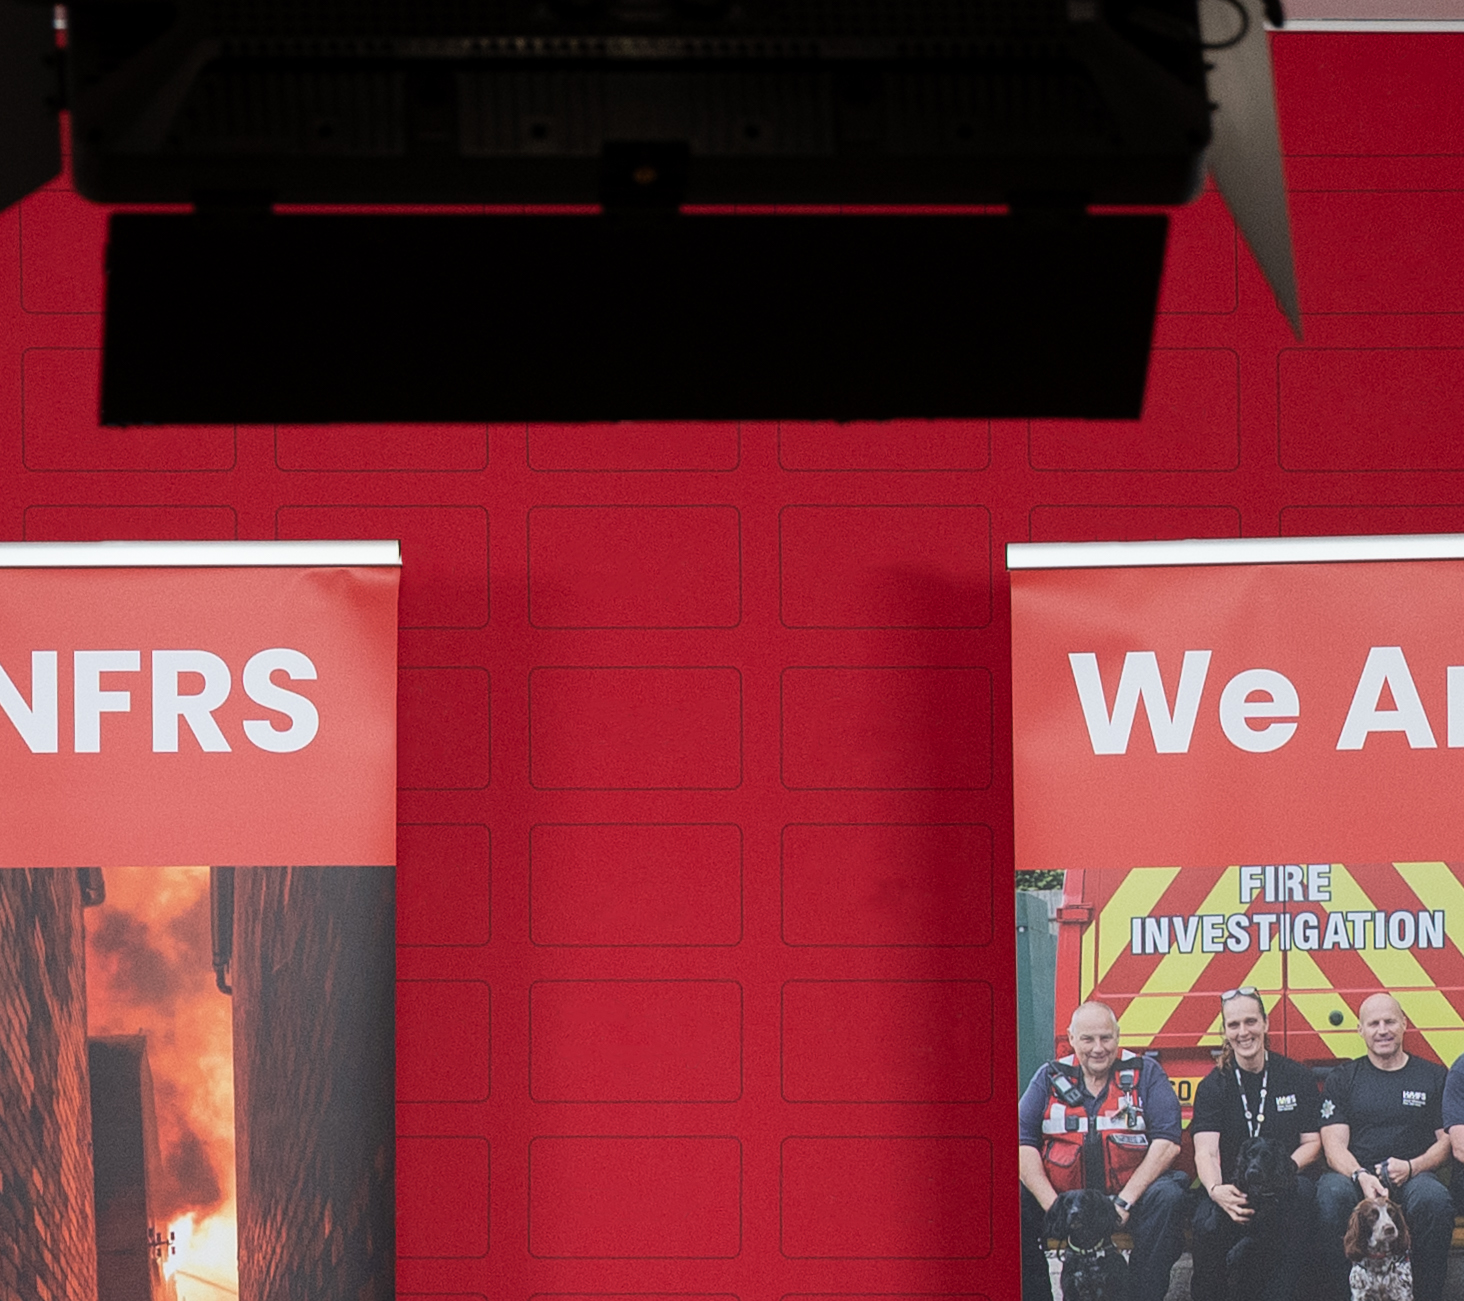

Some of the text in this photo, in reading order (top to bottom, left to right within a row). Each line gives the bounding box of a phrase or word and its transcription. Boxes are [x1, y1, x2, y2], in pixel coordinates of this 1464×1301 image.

[1068, 649, 1298, 756] We
[1239, 864, 1331, 904] FIRE
[1130, 910, 1445, 955] INVESTIGATION
